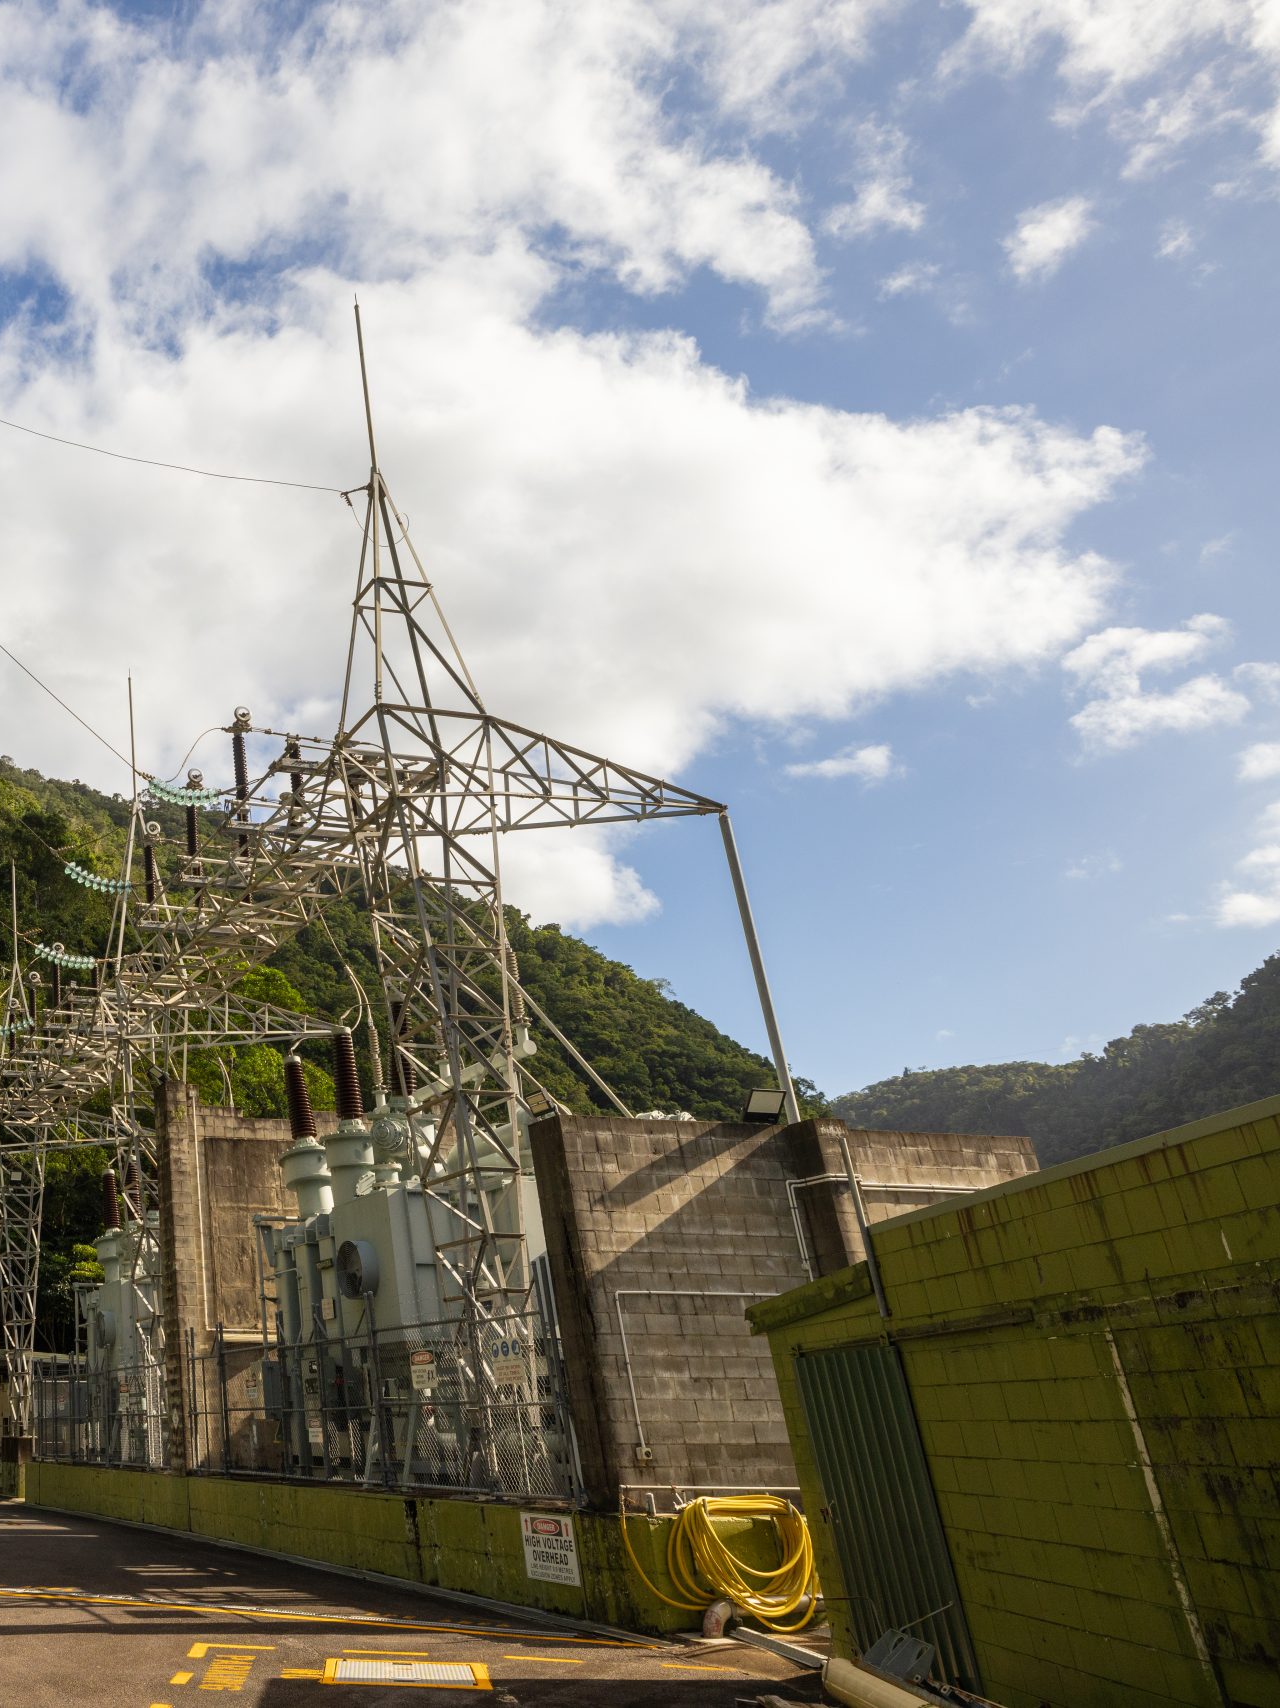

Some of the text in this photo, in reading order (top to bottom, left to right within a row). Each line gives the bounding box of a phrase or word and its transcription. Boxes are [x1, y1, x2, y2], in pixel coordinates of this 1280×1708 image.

[536, 1522, 556, 1532] DANGER
[525, 1535, 574, 1552] HIGH VOLTAGE
[532, 1550, 568, 1566] OVERHEAD
